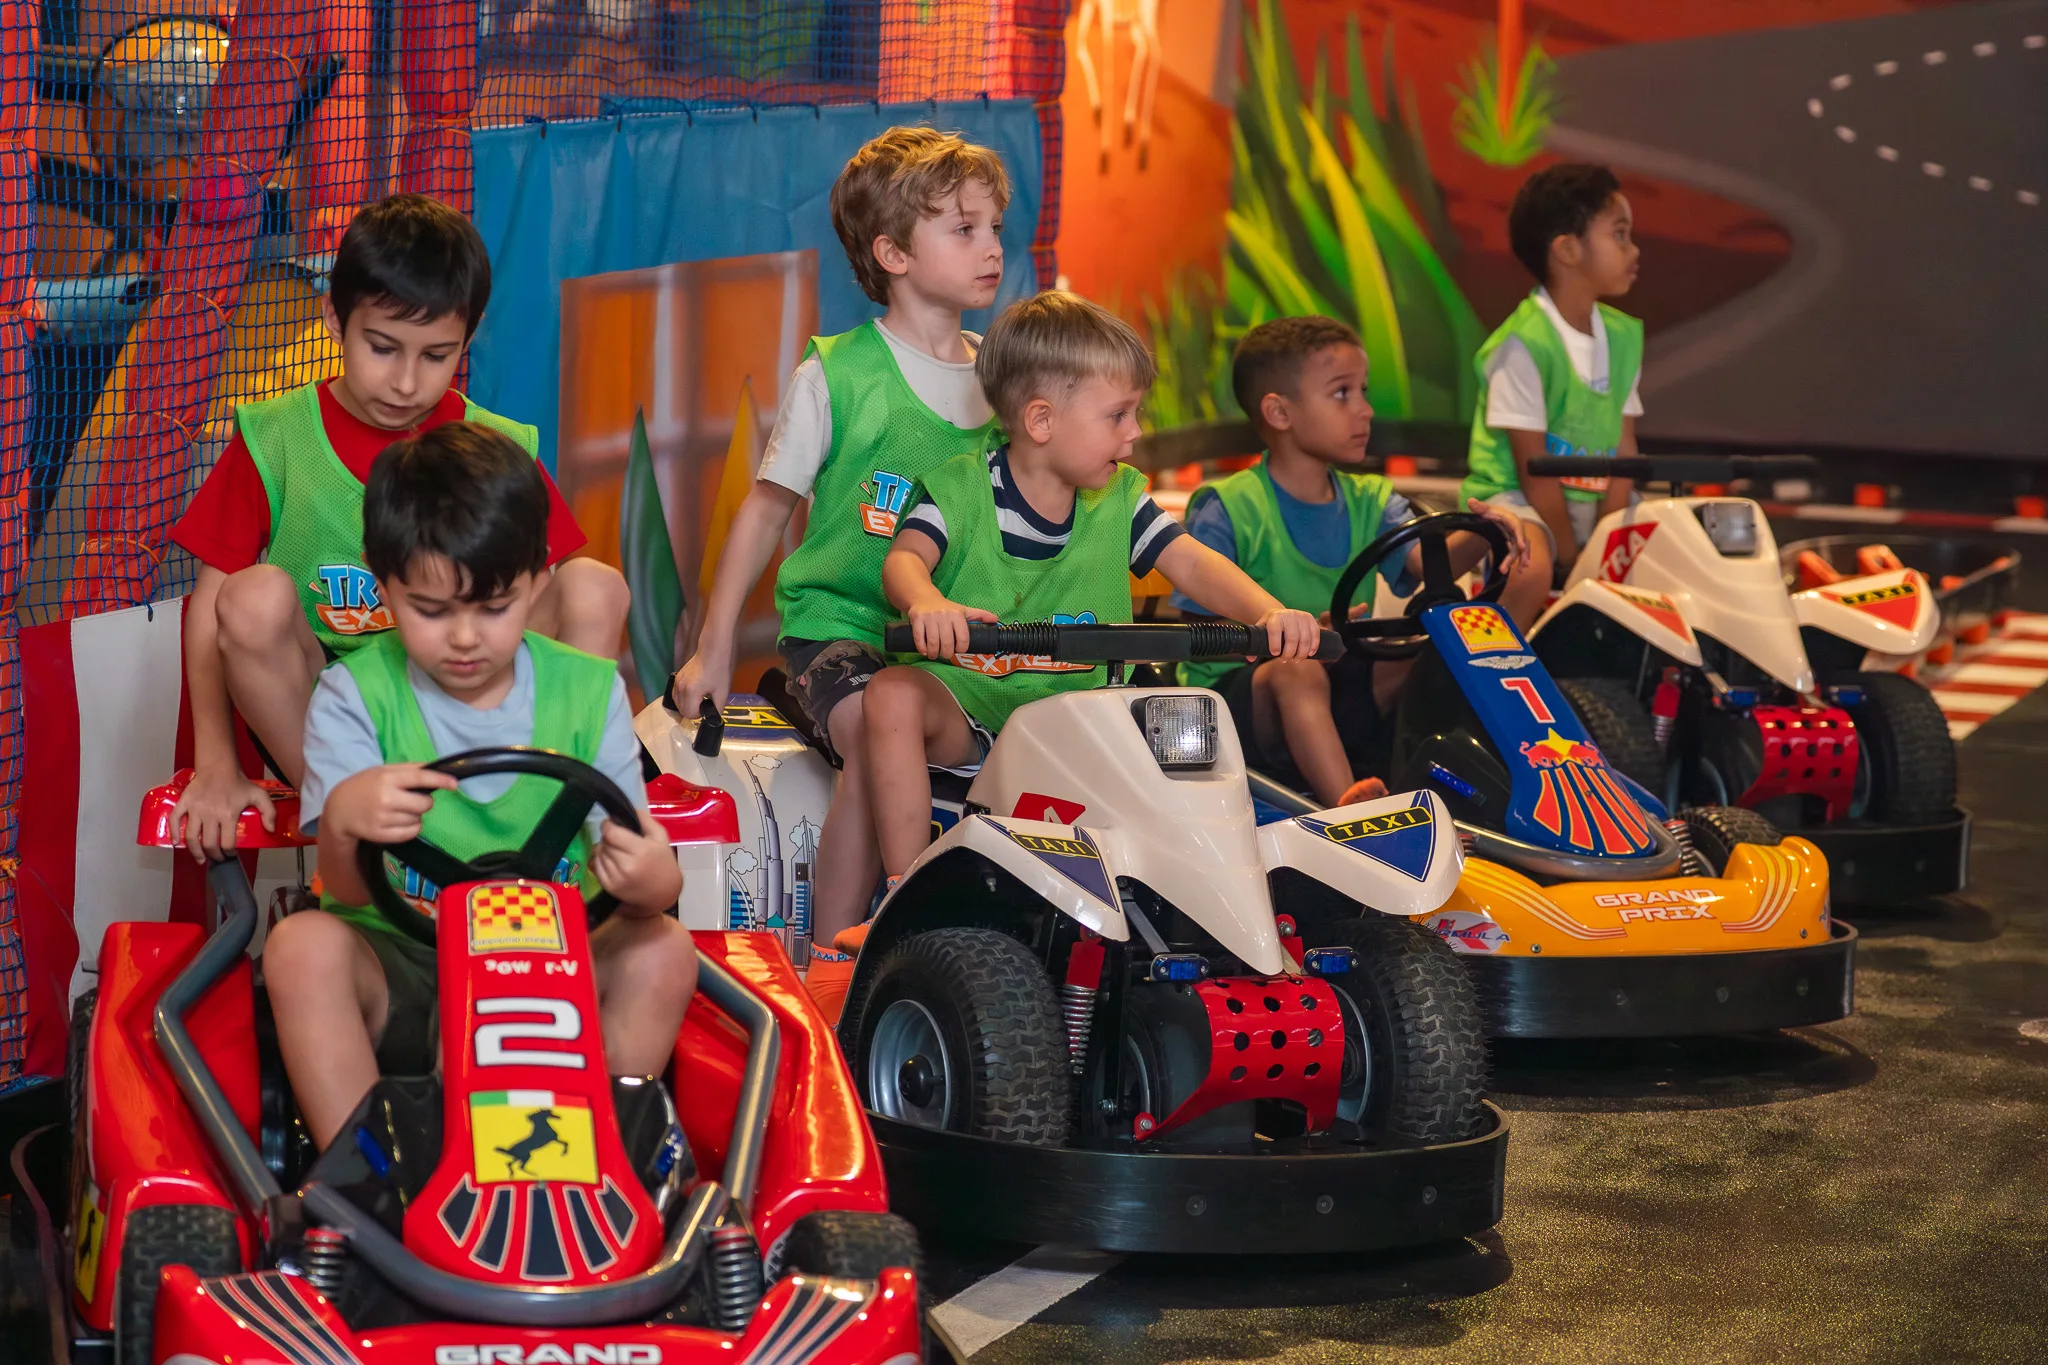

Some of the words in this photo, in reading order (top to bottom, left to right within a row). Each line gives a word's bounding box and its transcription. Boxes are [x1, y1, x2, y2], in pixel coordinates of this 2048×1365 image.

[1500, 677, 1556, 723] 1
[1337, 812, 1417, 837] TAXI
[1022, 836, 1087, 855] TAXI
[1594, 889, 1718, 907] GRAND
[1618, 904, 1717, 923] PRIX
[475, 996, 587, 1069] 2
[435, 1342, 662, 1365] GRAND
